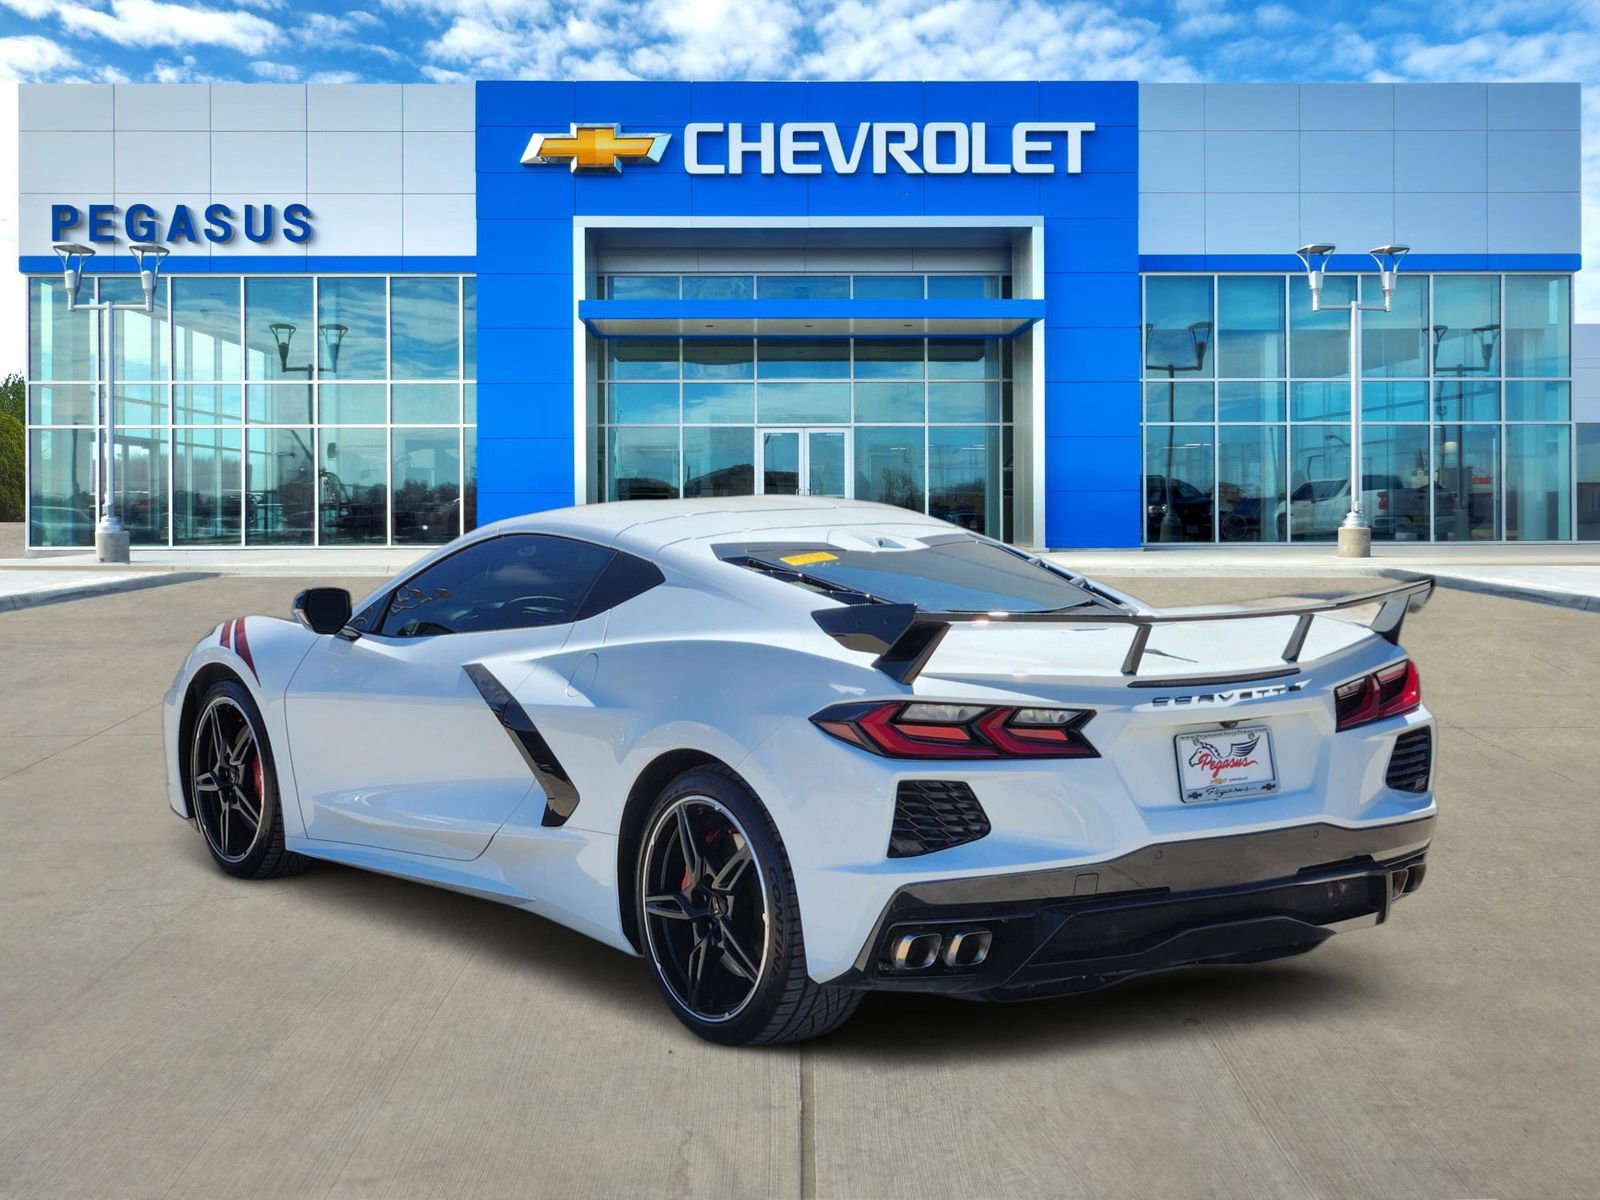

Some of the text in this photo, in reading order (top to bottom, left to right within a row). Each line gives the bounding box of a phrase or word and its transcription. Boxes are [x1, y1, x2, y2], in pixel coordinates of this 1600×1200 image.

[683, 122, 1096, 174] CHEVROLET
[51, 203, 314, 244] PEGASUS
[1198, 752, 1258, 778] Pegasus
